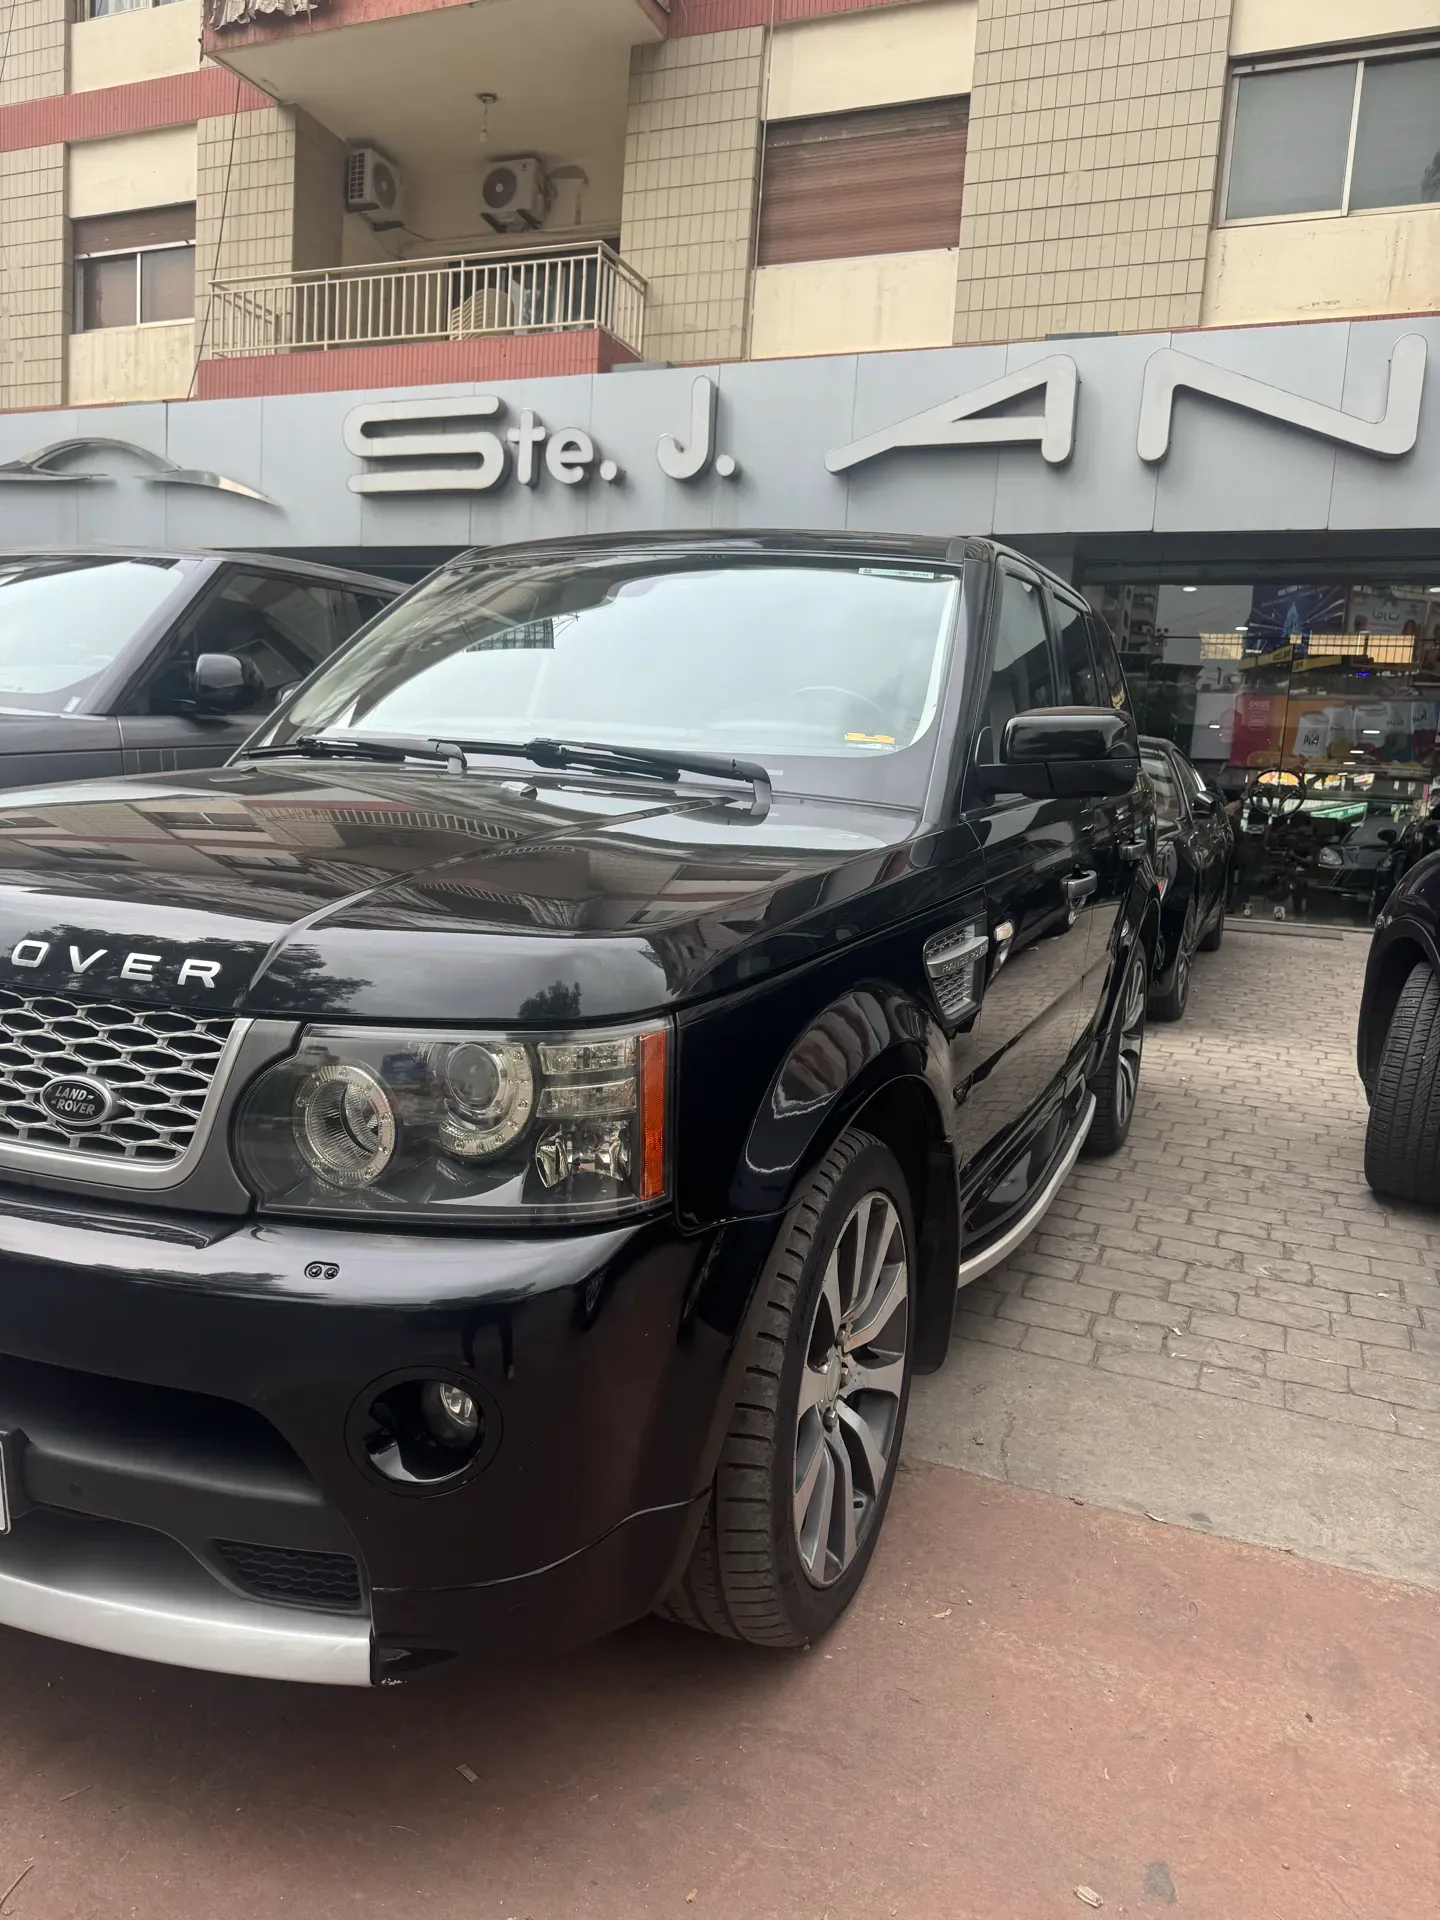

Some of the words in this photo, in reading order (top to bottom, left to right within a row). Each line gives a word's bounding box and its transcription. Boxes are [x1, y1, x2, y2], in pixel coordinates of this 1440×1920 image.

[341, 394, 621, 494] Ste.
[655, 374, 737, 480] J.
[823, 332, 1429, 475] AN
[11, 940, 222, 989] OVER
[55, 1085, 88, 1101] LAND
[56, 1098, 96, 1115] ROVER
